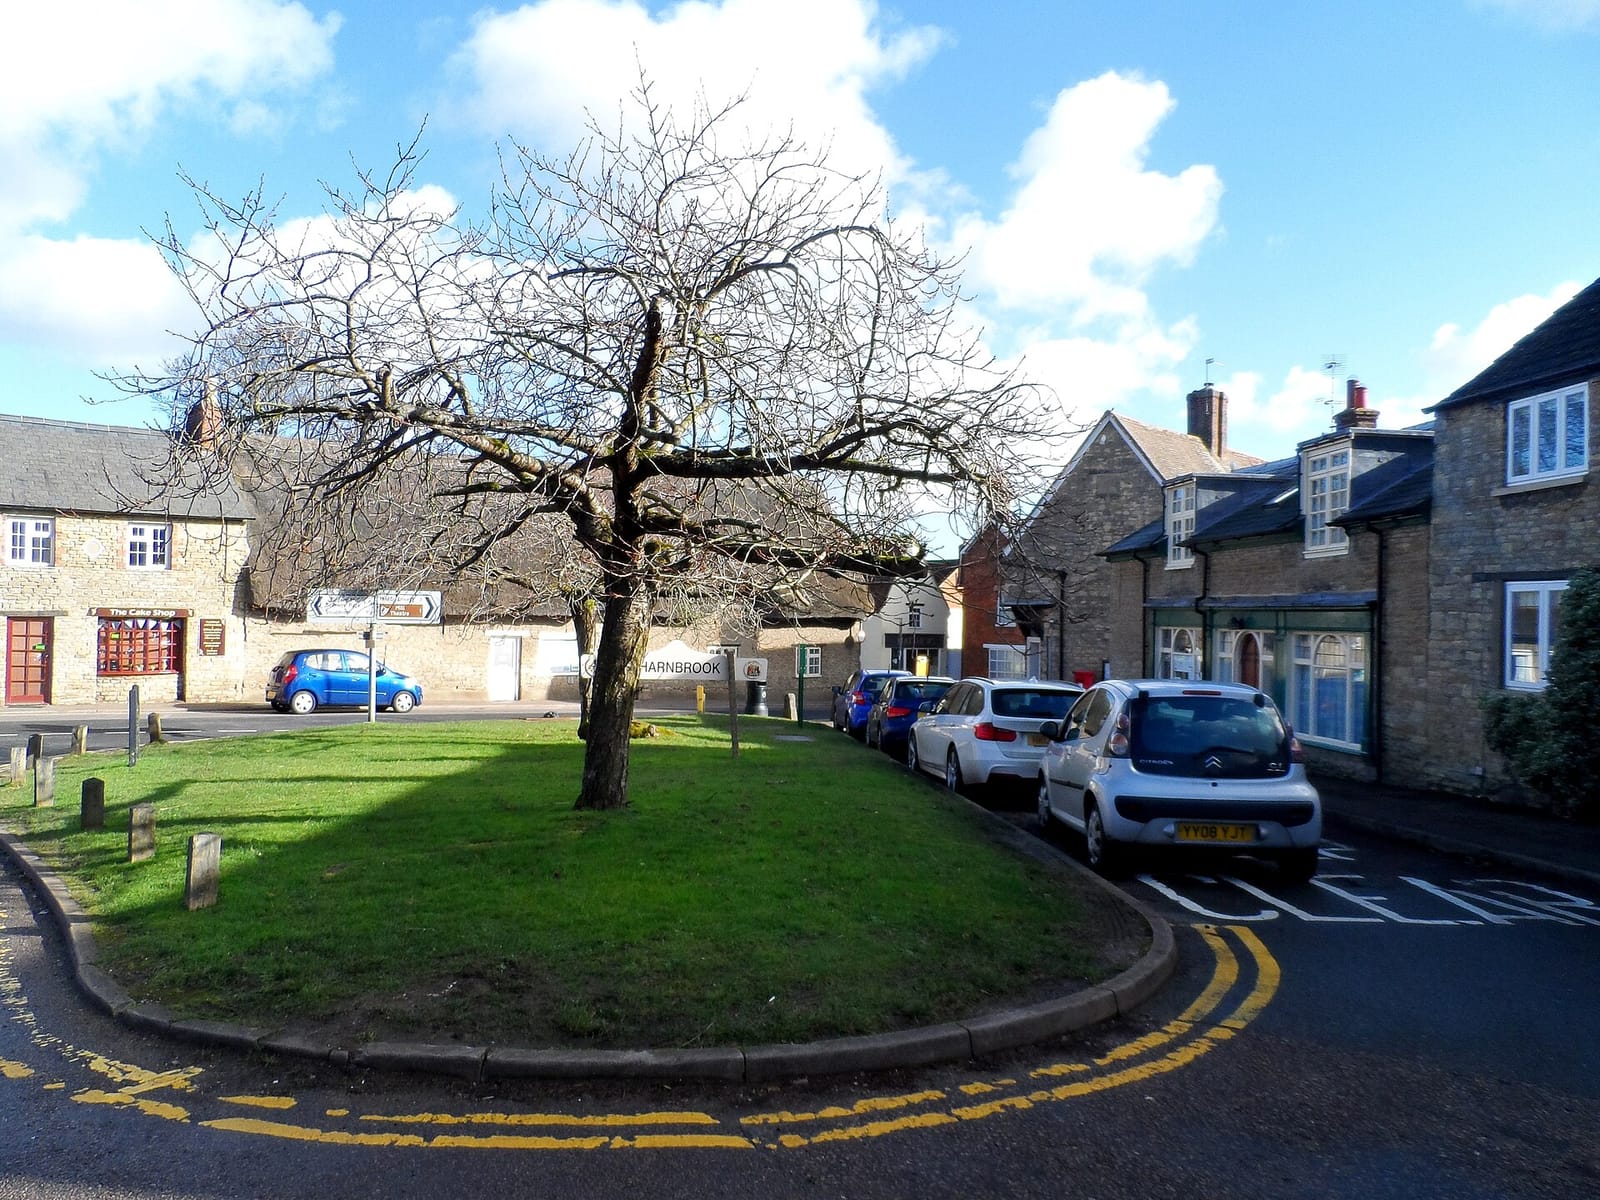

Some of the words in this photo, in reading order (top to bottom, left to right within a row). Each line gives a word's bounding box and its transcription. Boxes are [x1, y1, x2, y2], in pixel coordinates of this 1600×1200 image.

[110, 608, 127, 616] The
[129, 608, 152, 616] Cake
[152, 608, 176, 618] Shop
[641, 661, 721, 674] HARNBROOK
[1183, 826, 1217, 838] YY08
[1222, 826, 1246, 839] YJT
